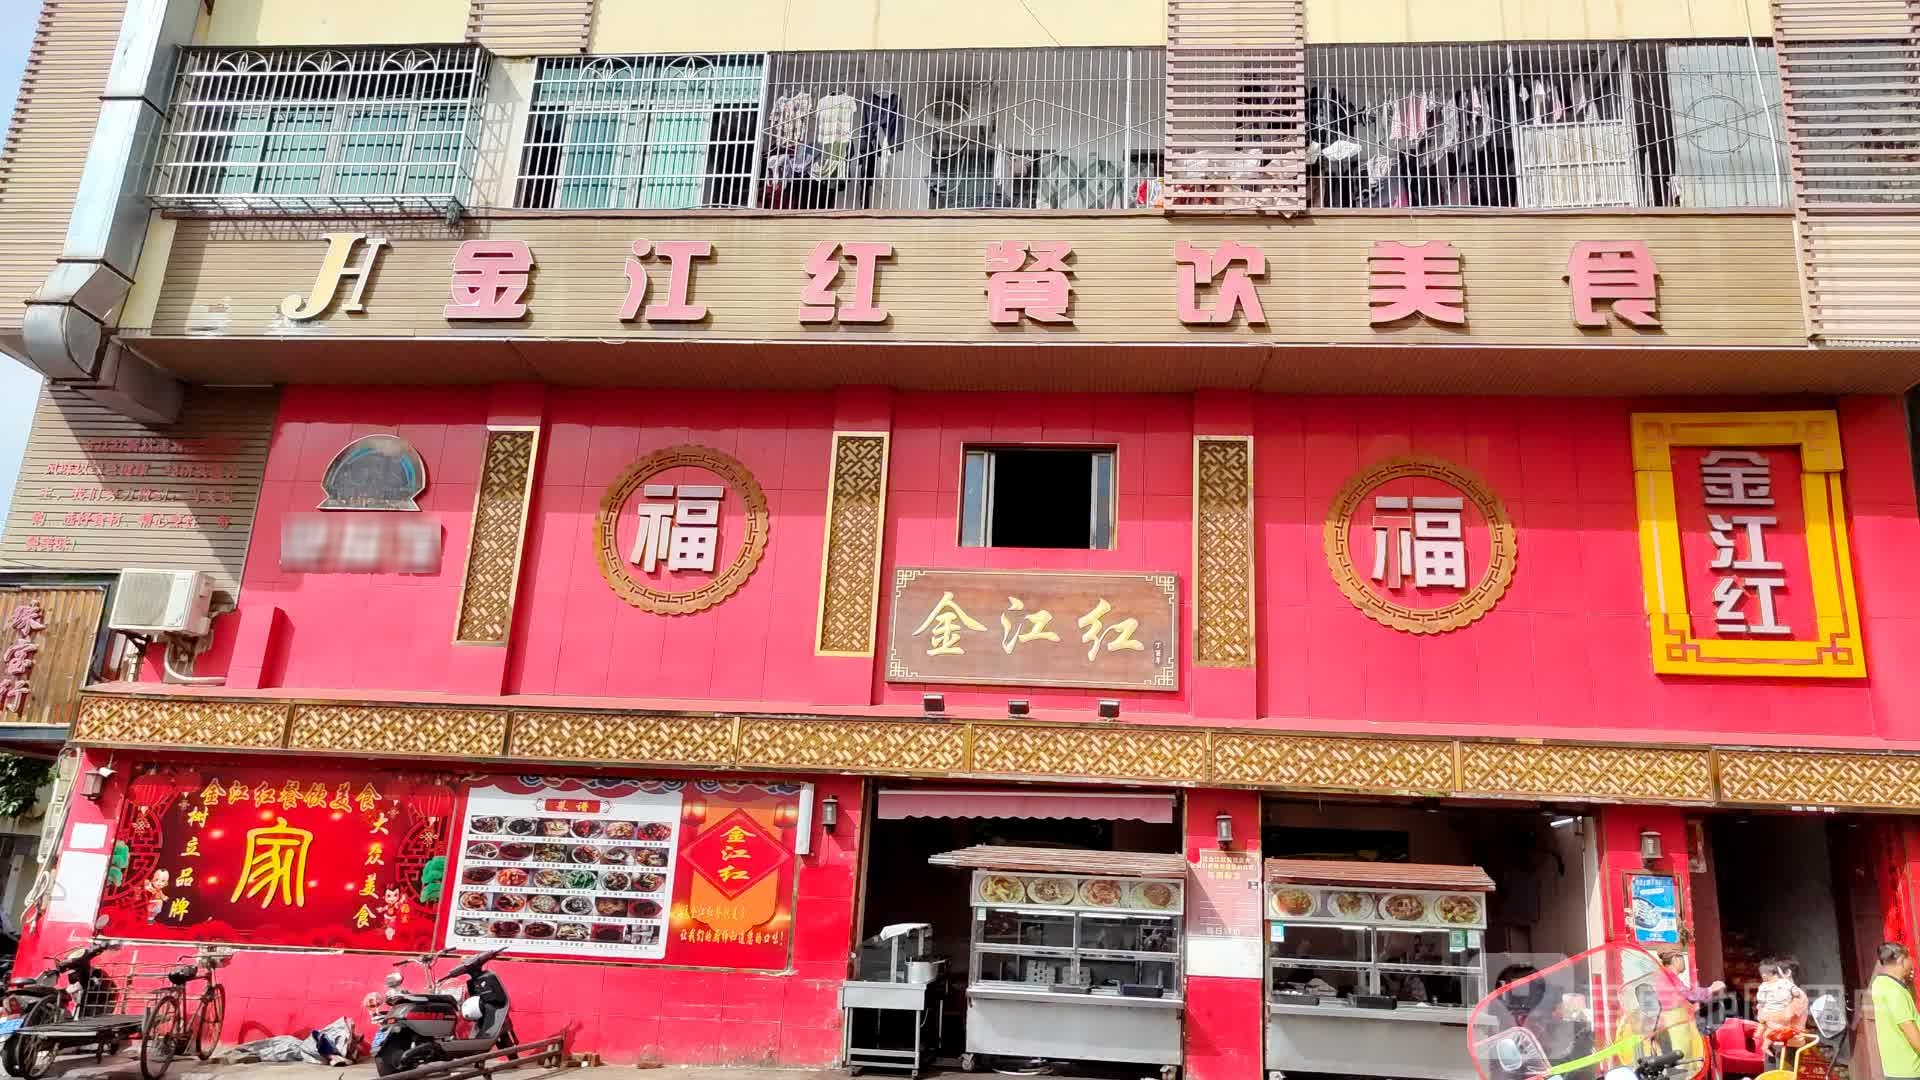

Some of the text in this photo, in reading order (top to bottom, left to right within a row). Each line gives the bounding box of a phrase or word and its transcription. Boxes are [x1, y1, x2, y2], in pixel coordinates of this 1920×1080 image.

[443, 237, 1664, 328] 金江红餐饮美食
[629, 484, 724, 574] 福
[1370, 496, 1467, 590] 福
[1701, 449, 1792, 635] 金江红
[912, 591, 1145, 663] 金江红
[200, 778, 383, 814] 金江红餐饮美食
[168, 805, 209, 922] 树立品牌
[230, 816, 314, 910] 家
[352, 812, 390, 929] 大众美食
[717, 825, 758, 883] 金江红
